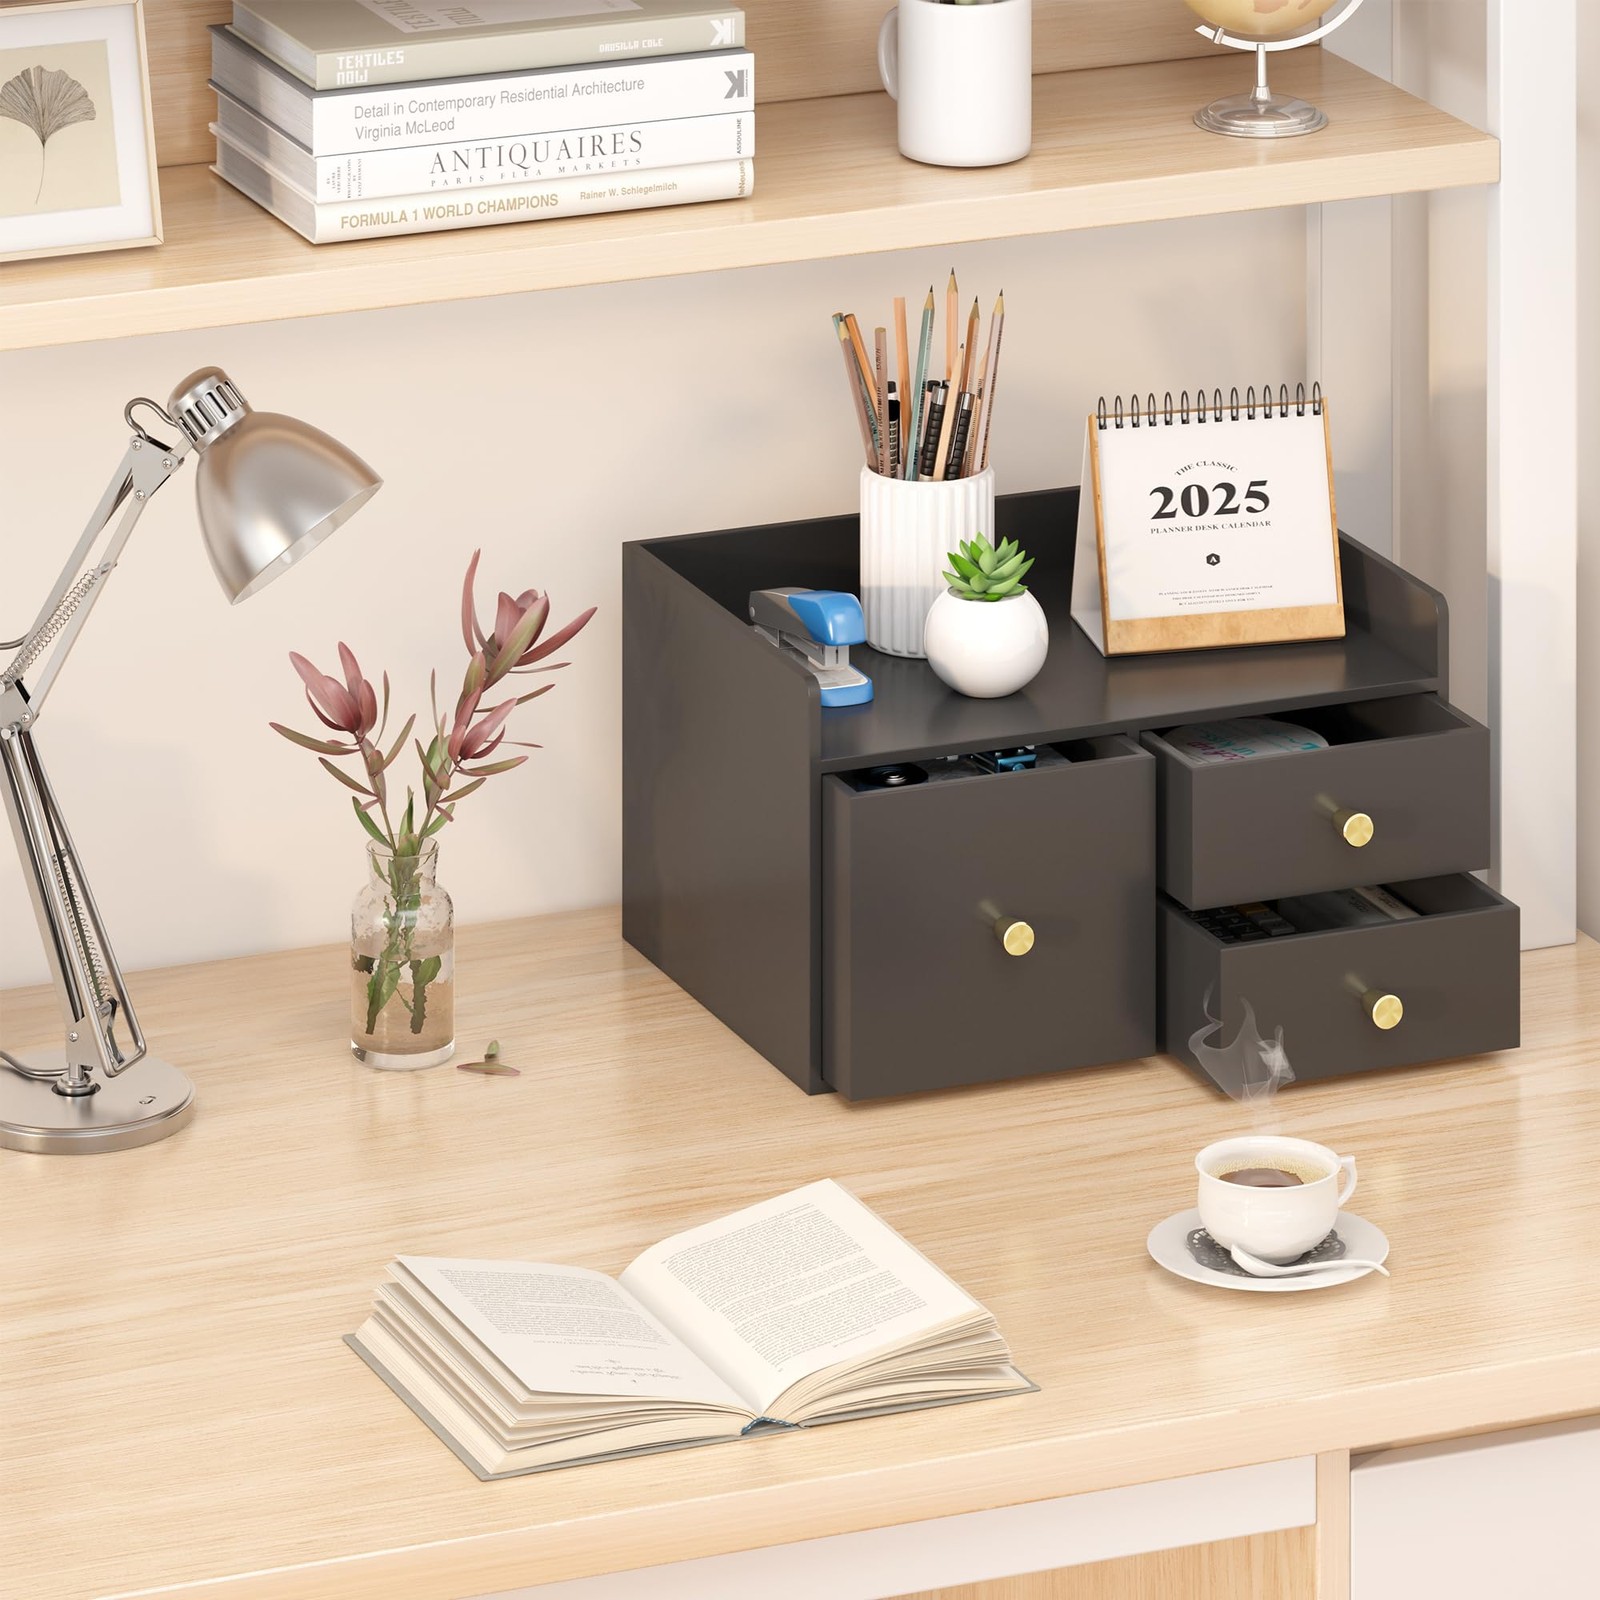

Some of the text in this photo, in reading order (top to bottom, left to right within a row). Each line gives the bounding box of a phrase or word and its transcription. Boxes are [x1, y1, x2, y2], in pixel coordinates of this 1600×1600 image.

[336, 50, 404, 70] TEXTILES
[336, 69, 368, 85] NOW
[354, 79, 645, 119] Detail in Contemporary Residential Architecture
[355, 117, 455, 142] Virginia McLeod
[430, 130, 643, 174] ANTIQUAIRES
[431, 158, 642, 187] PARIS FLEA MARKETS
[580, 182, 678, 201] Rainer W. Schlegelmilch
[340, 194, 559, 229] FORMULA 1 WORLD CHAMPIONS
[1174, 460, 1238, 476] THE CLASSIC
[1149, 480, 1270, 520] 2025
[1150, 520, 1272, 535] PLANNER DESK CALENDAR
